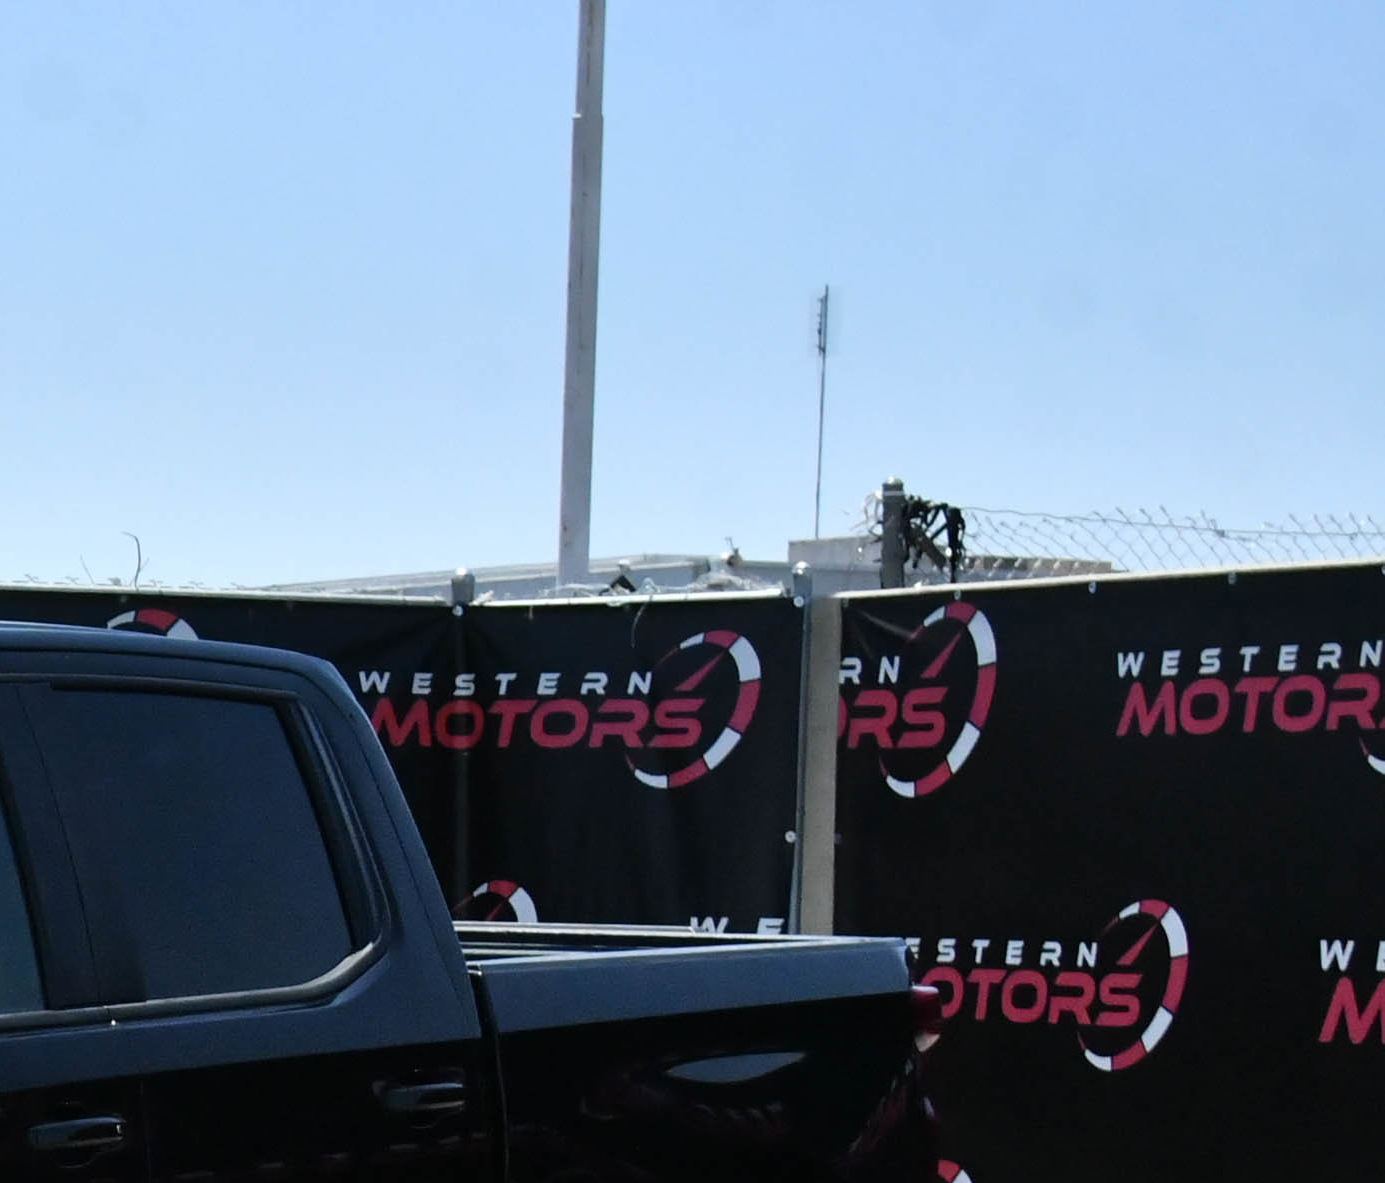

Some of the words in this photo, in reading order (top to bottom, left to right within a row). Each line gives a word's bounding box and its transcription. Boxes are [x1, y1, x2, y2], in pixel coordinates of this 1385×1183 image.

[1116, 639, 1384, 679] WESTERN
[358, 670, 653, 696] WESTERN
[1116, 672, 1385, 737] MOTOR
[371, 698, 705, 750] MOTORS
